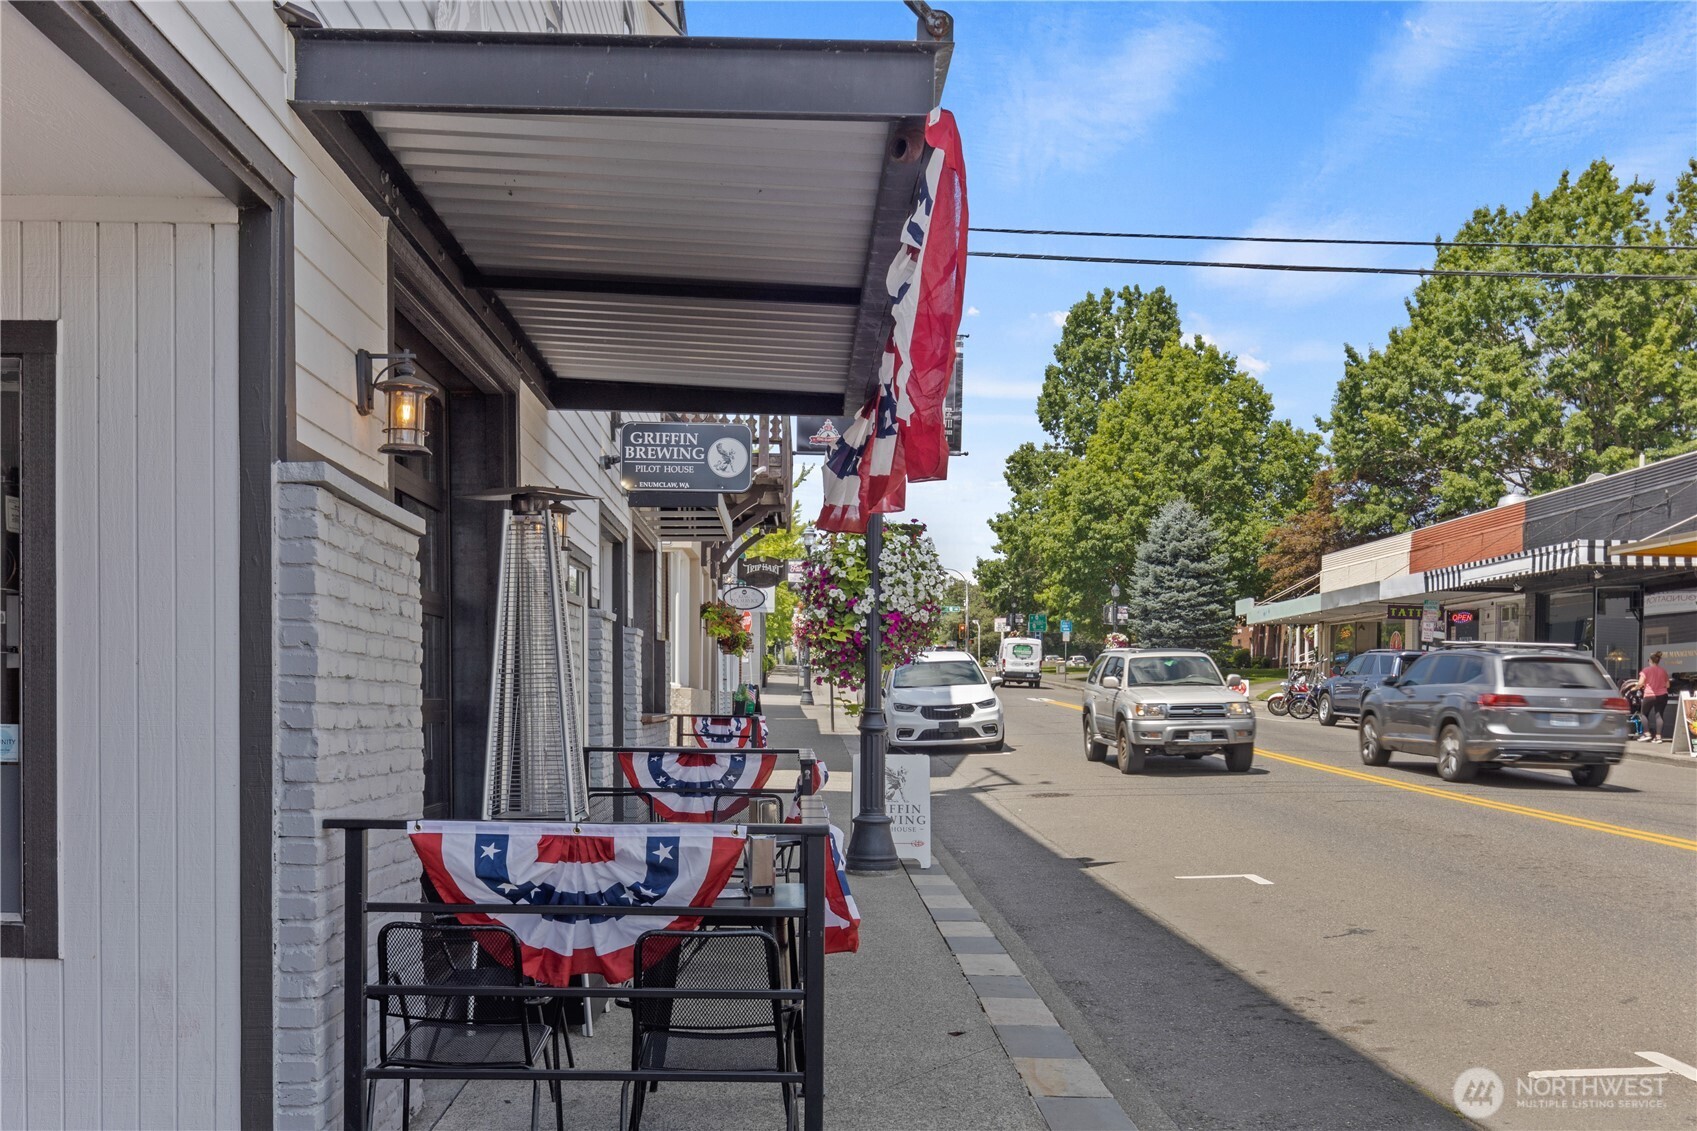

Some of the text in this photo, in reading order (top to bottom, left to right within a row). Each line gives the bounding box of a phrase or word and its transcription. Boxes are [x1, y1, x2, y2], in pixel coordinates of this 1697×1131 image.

[630, 431, 699, 445] GRIFFIN
[624, 446, 705, 460] BREWING
[635, 464, 695, 474] PILOT HOUSE
[1390, 607, 1441, 617] TATT
[889, 804, 921, 814] FFIN
